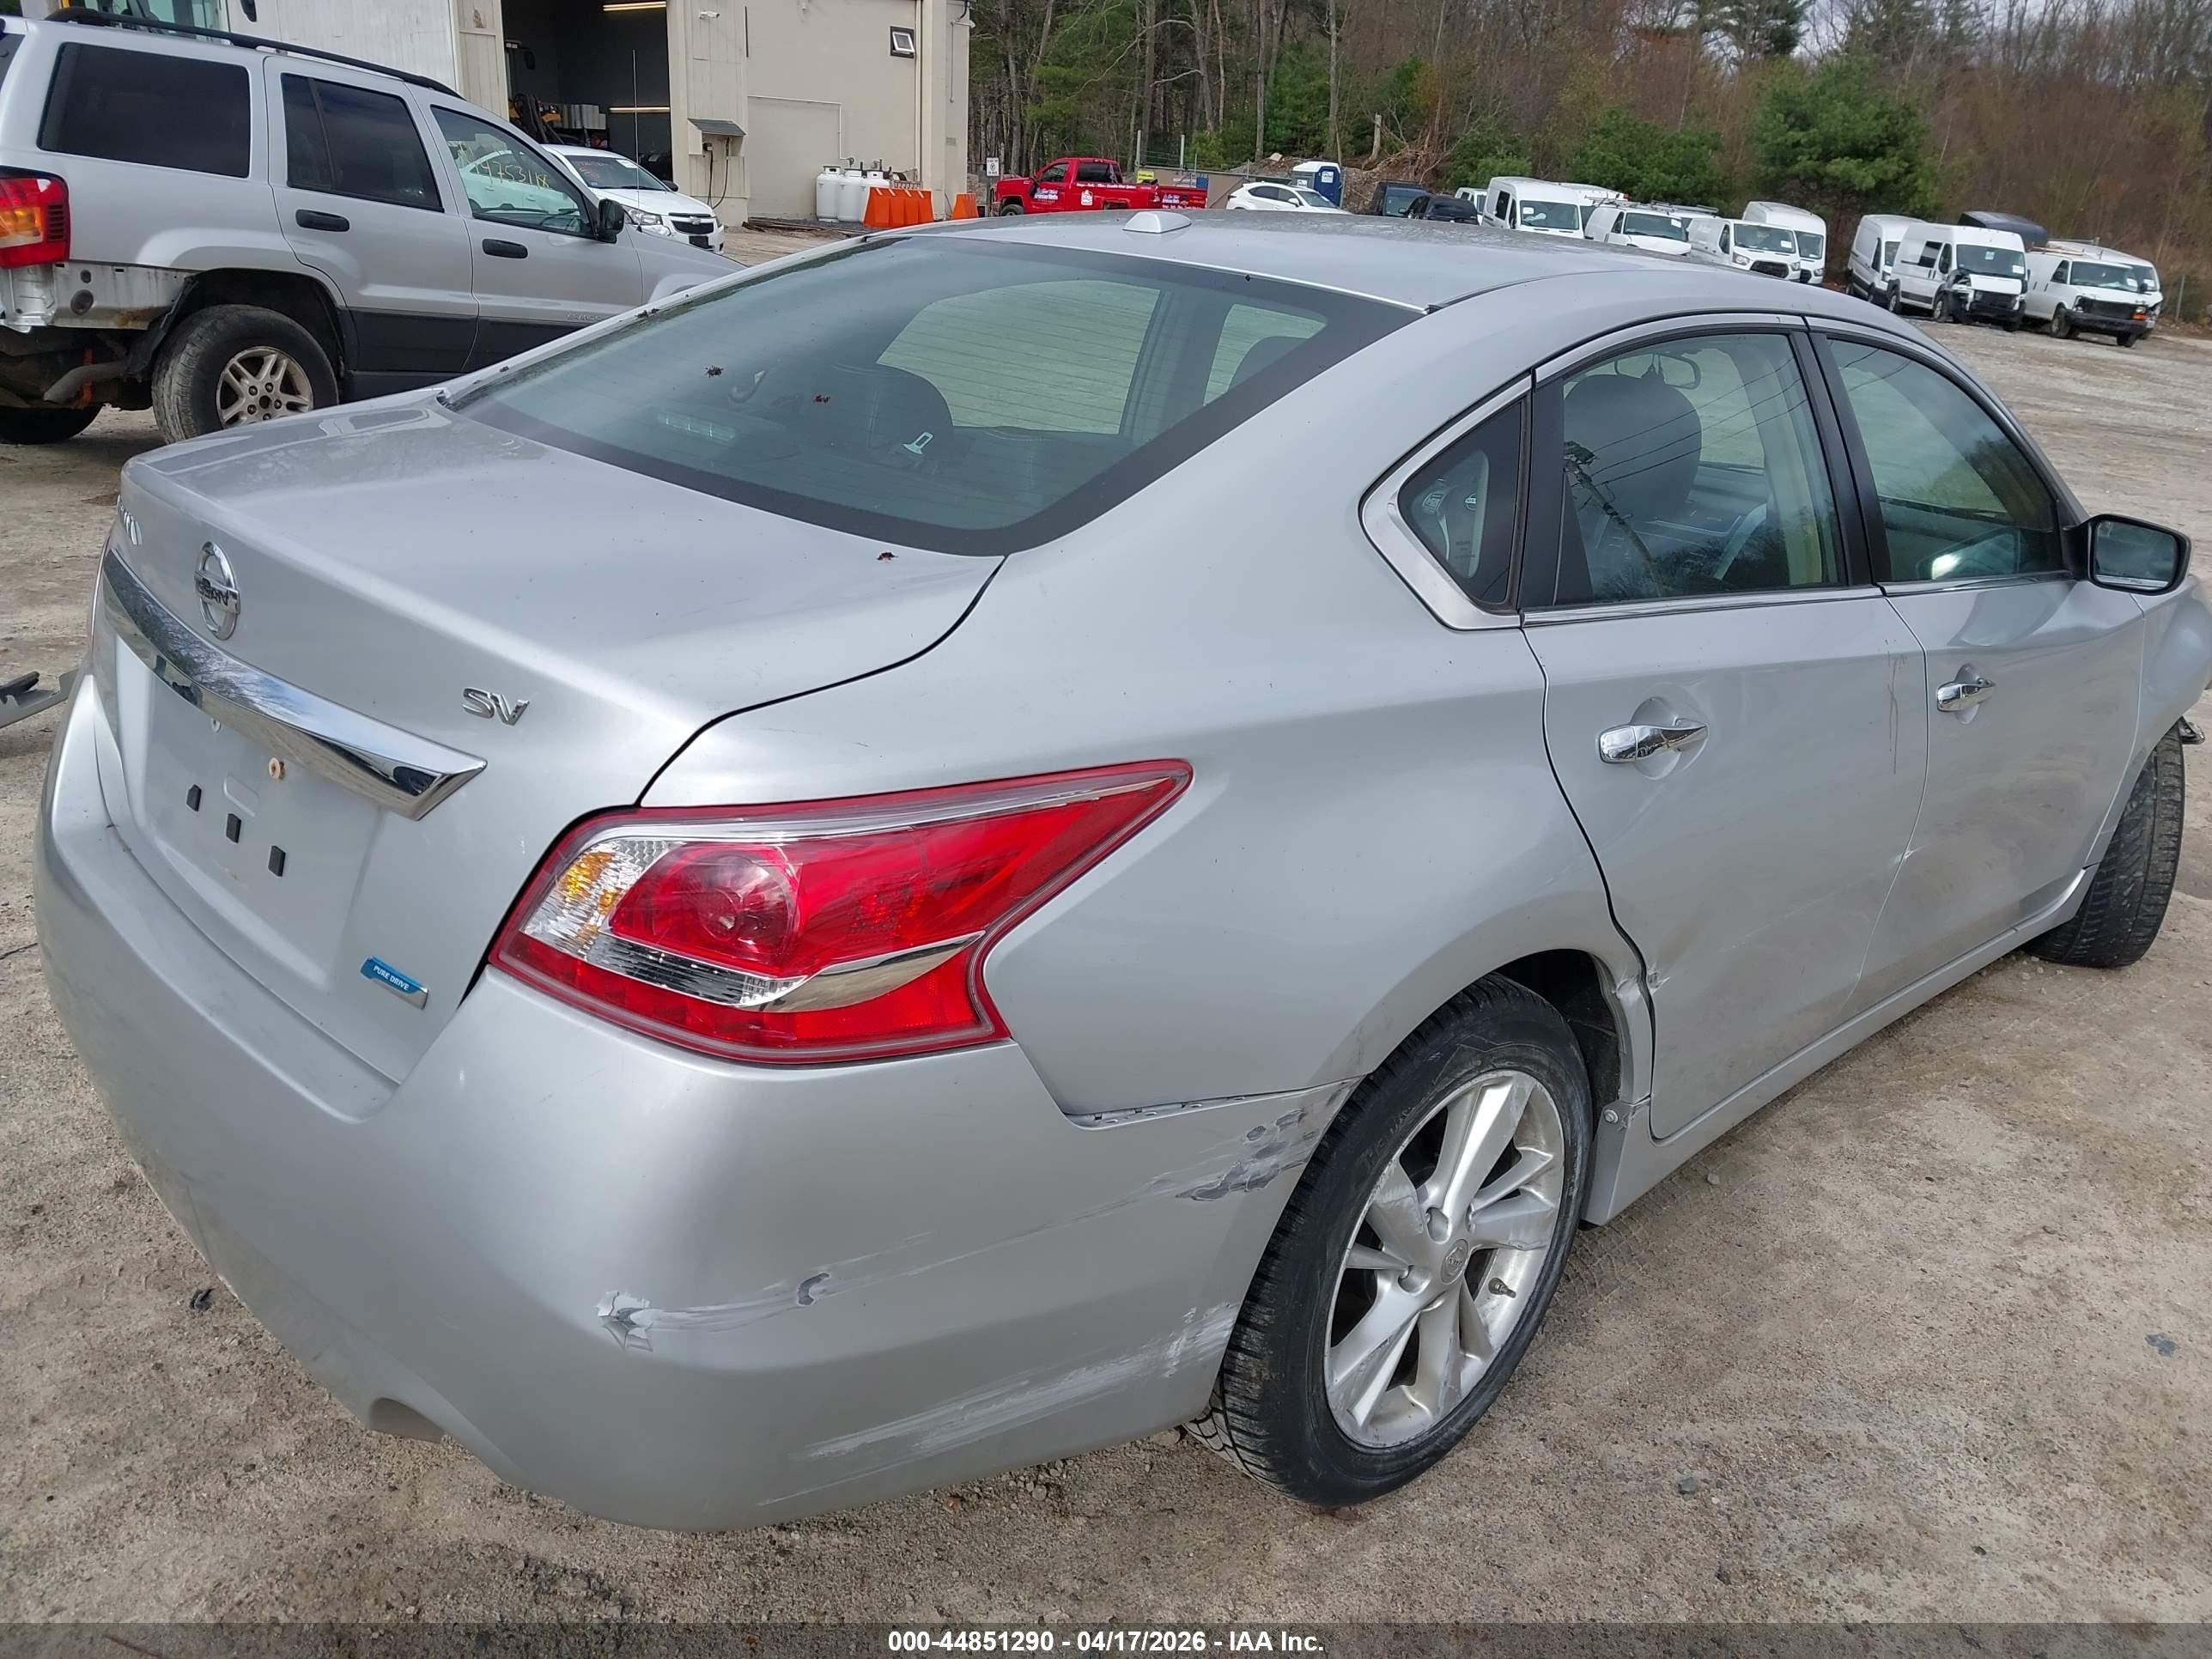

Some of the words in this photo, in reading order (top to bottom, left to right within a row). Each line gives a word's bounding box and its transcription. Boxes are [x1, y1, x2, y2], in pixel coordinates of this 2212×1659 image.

[462, 686, 530, 726] SV
[373, 965, 391, 980] PURE
[389, 975, 410, 991] DRIVE
